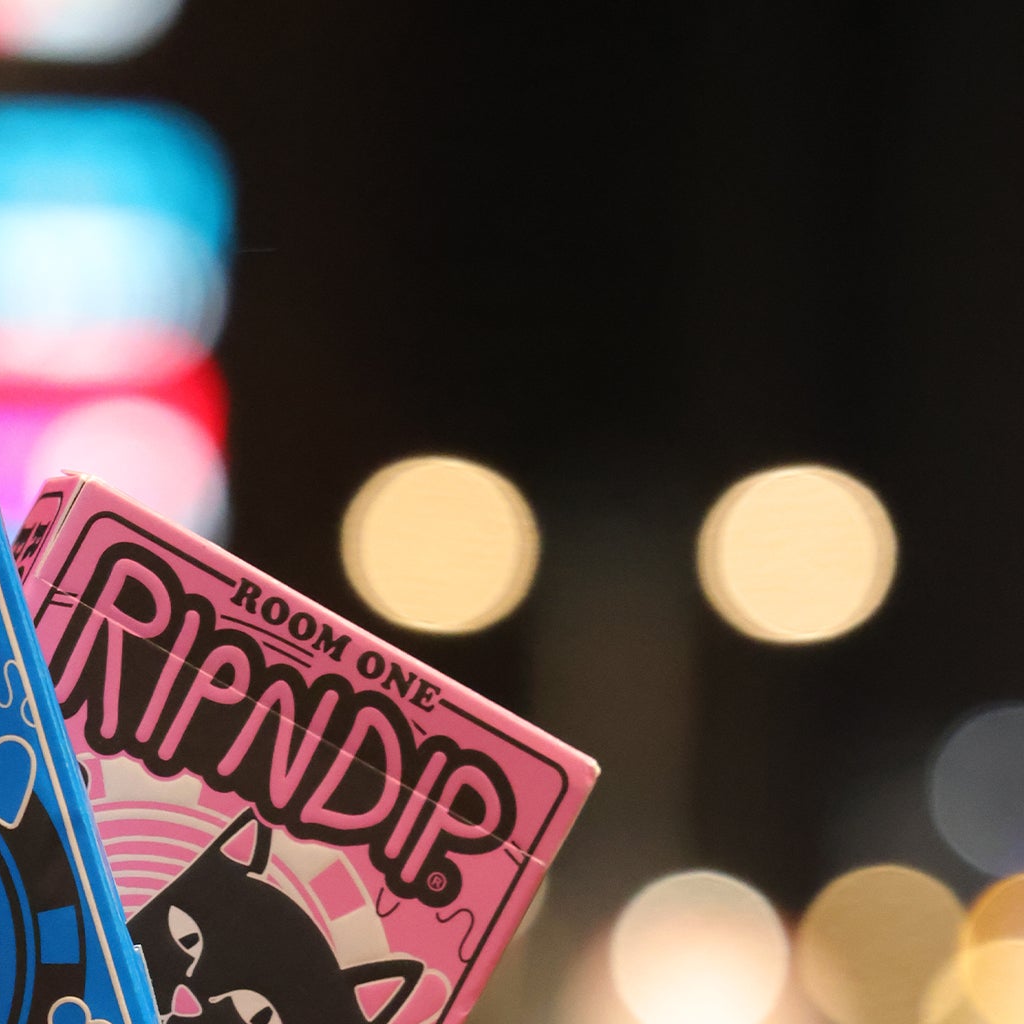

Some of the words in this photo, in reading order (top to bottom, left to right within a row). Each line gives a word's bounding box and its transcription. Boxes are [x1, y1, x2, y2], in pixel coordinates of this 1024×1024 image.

[52, 557, 505, 886] RIPNDIP
[229, 577, 353, 662] ROOM
[355, 650, 441, 713] ONE
